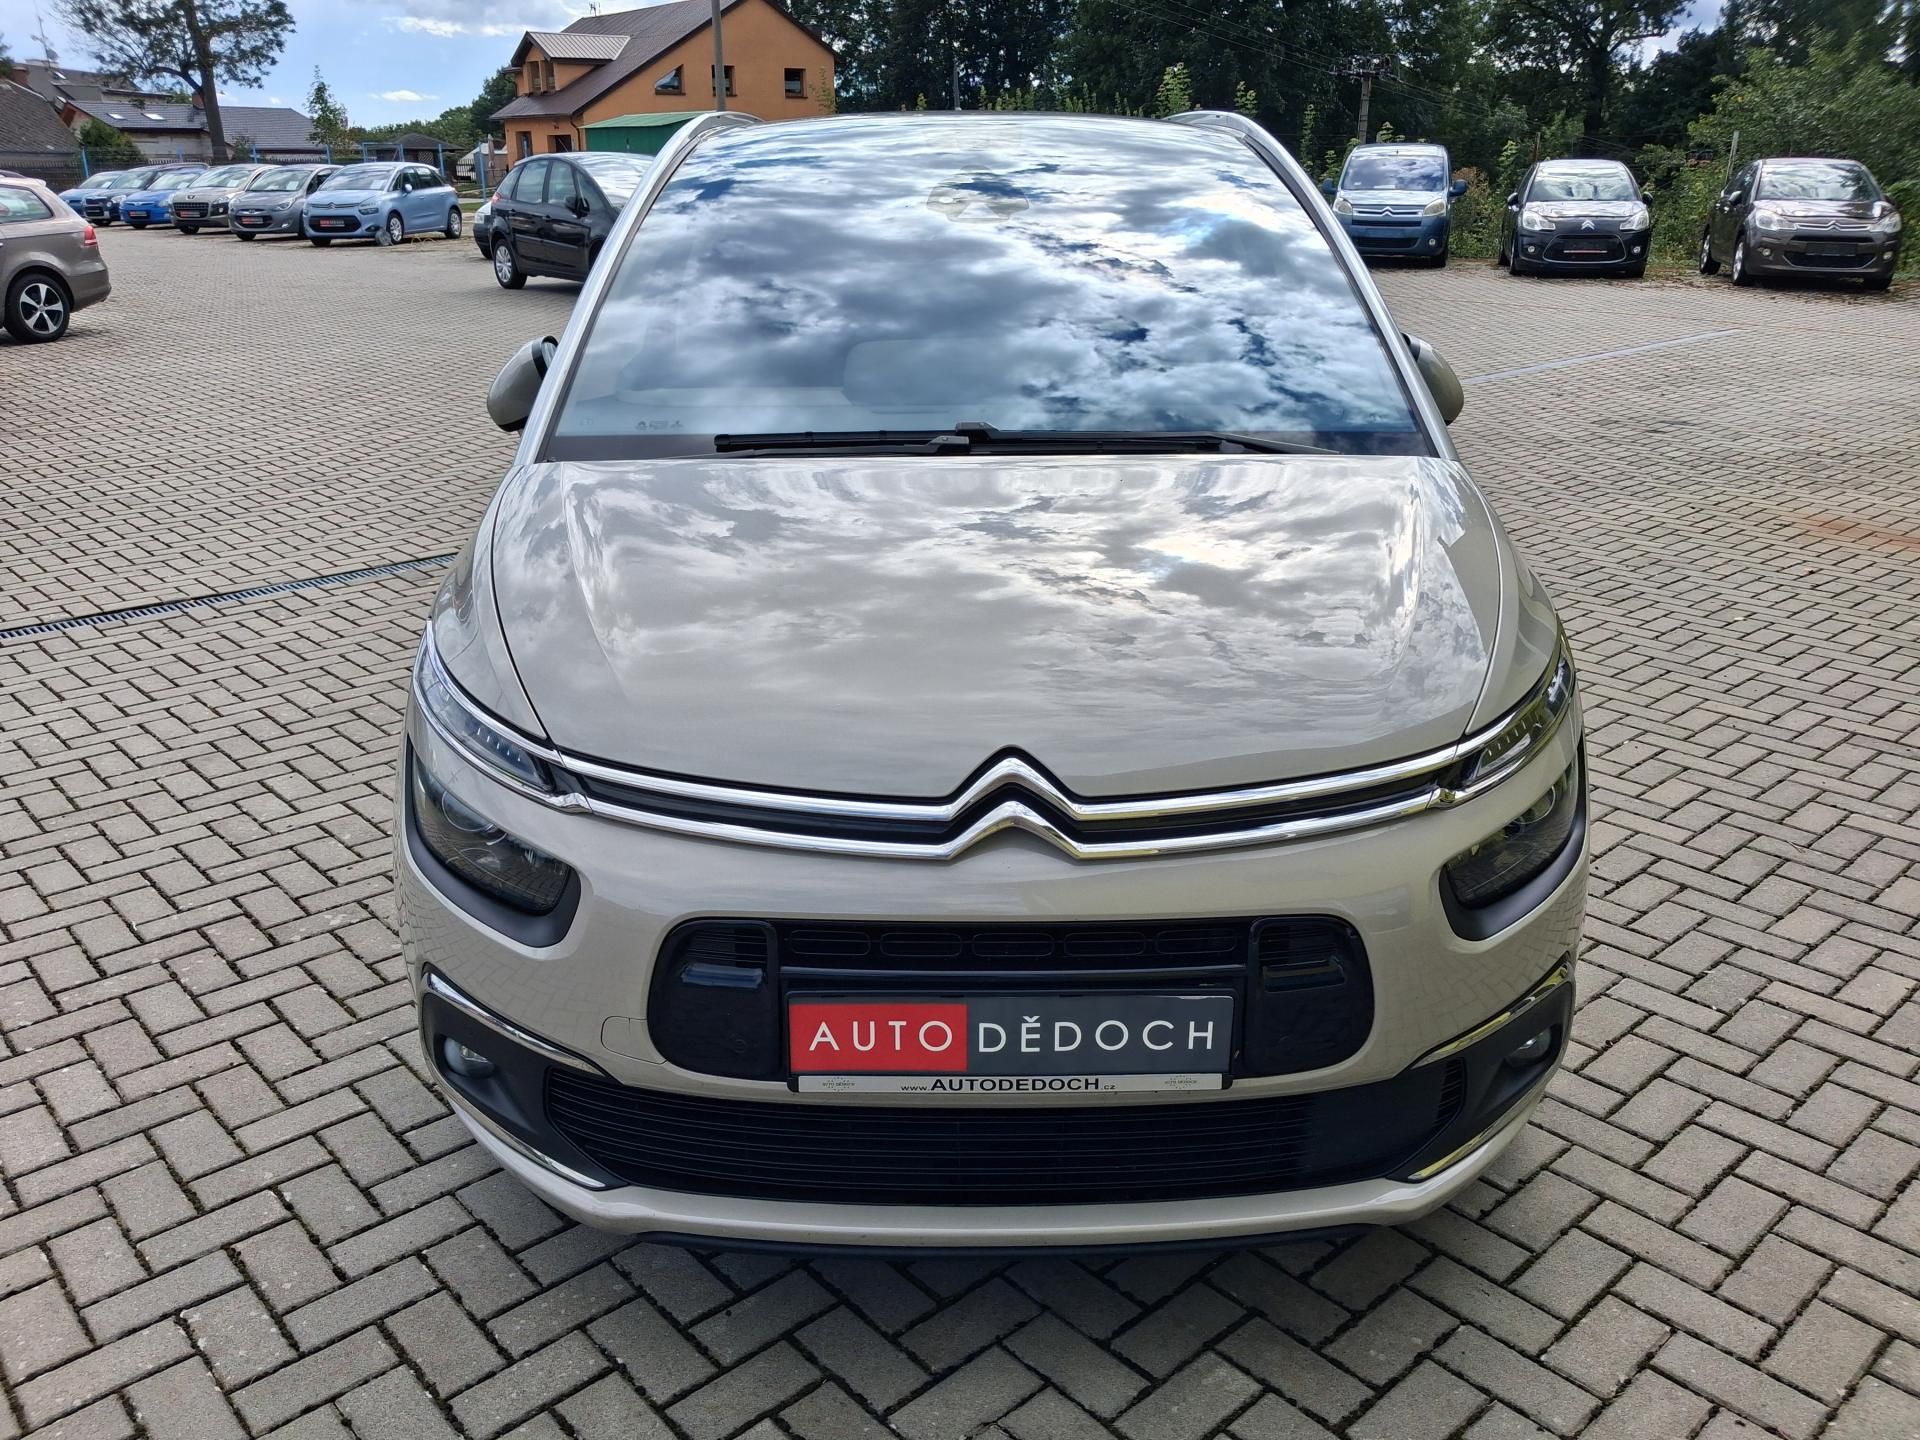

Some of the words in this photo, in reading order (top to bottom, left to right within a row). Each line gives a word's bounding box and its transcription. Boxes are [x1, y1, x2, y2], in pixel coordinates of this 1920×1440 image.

[809, 1021, 953, 1052] AUTO
[978, 1015, 1213, 1053] DĚDOCH
[900, 1078, 1116, 1092] www.AUTODEDOCH.cz
